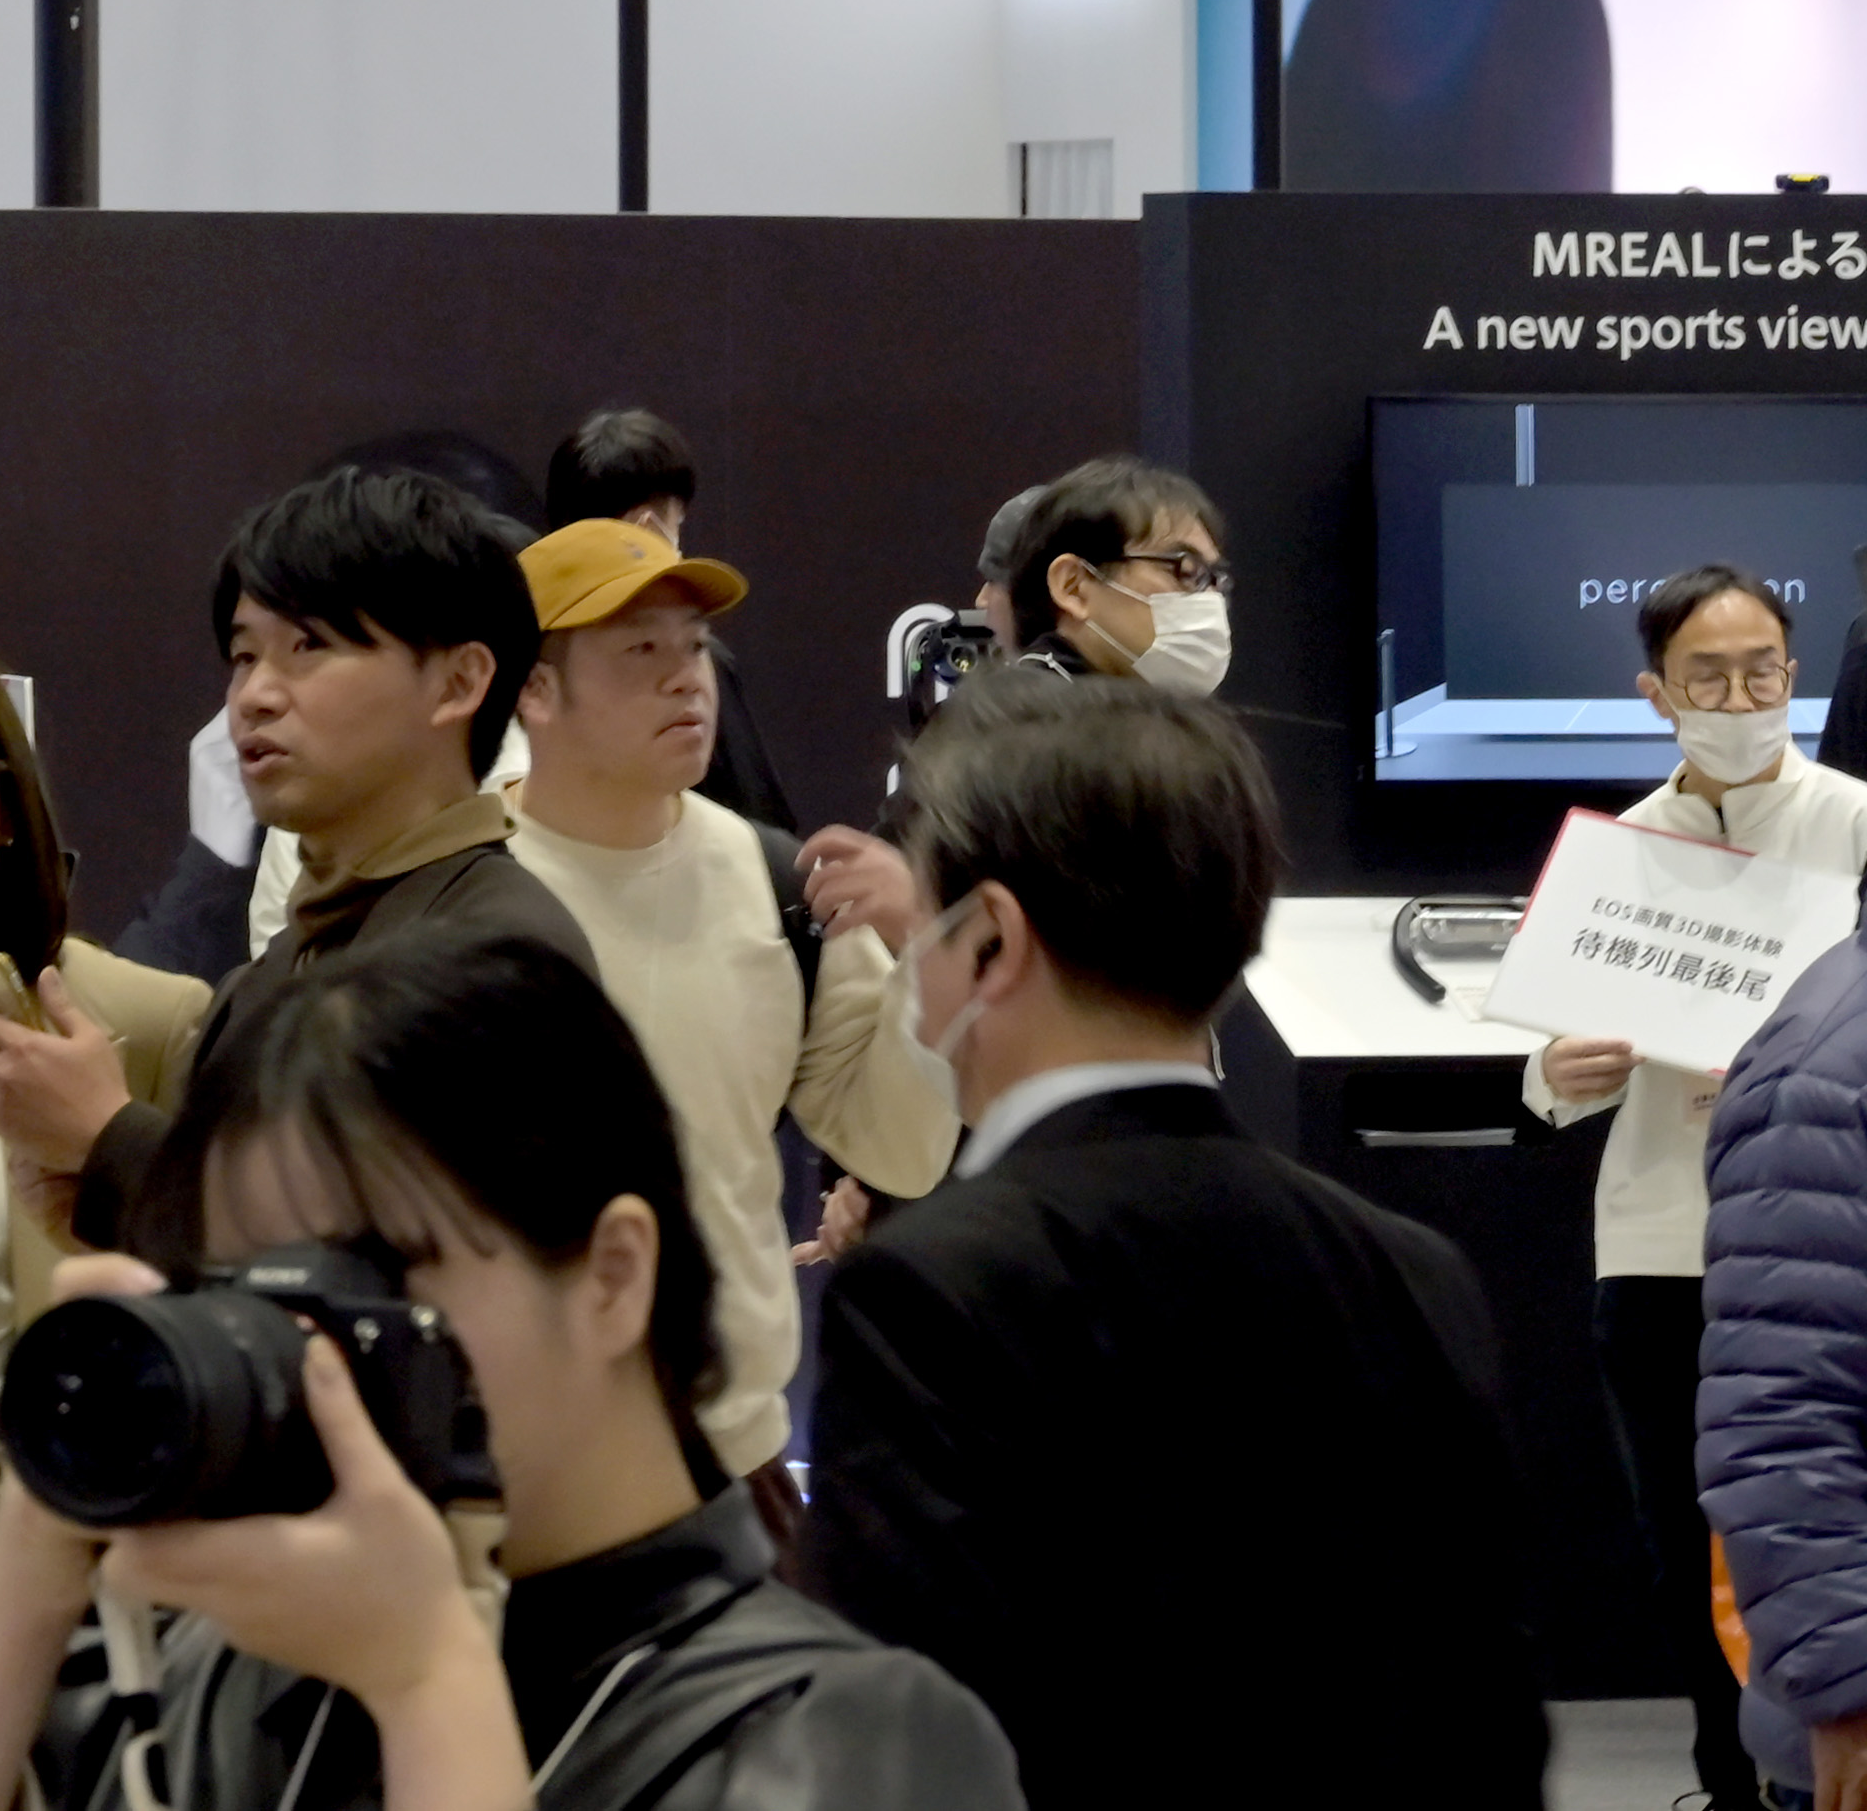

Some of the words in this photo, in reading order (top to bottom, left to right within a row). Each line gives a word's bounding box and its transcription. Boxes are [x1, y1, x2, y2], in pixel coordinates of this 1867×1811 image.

[1531, 228, 1867, 281] MREALによる
[1422, 304, 1465, 351] A
[1476, 311, 1586, 351] new
[1595, 307, 1747, 362] sports
[1757, 303, 1867, 351] view
[1590, 895, 1786, 959] EOS画質3D撮影体験
[1570, 926, 1773, 1003] 待機列最後尾
